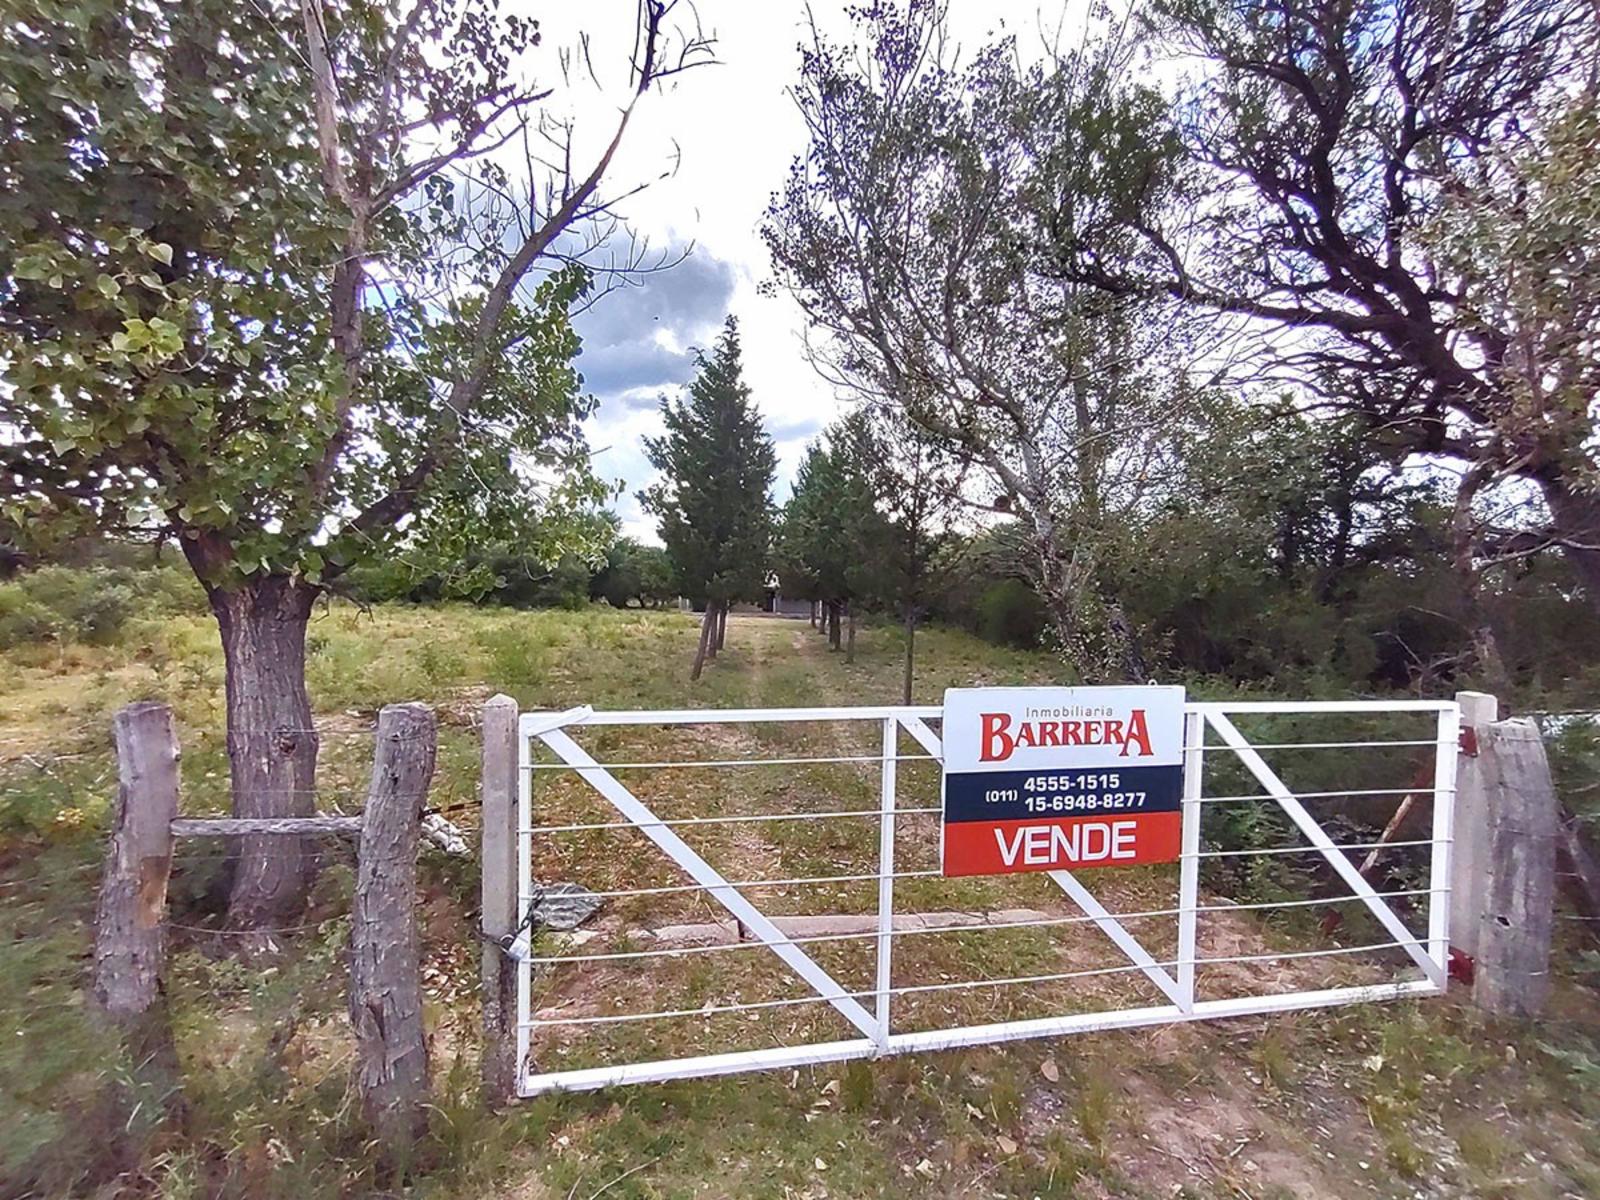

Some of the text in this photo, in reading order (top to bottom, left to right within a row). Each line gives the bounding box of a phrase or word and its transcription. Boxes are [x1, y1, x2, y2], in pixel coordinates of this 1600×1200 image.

[1026, 706, 1113, 718] Inmobiliaria
[979, 709, 1154, 762] BARRERA
[1023, 774, 1120, 792] 4555-1515
[985, 789, 1146, 812] (011) 15-6948-8277
[993, 821, 1137, 866] VENDE
